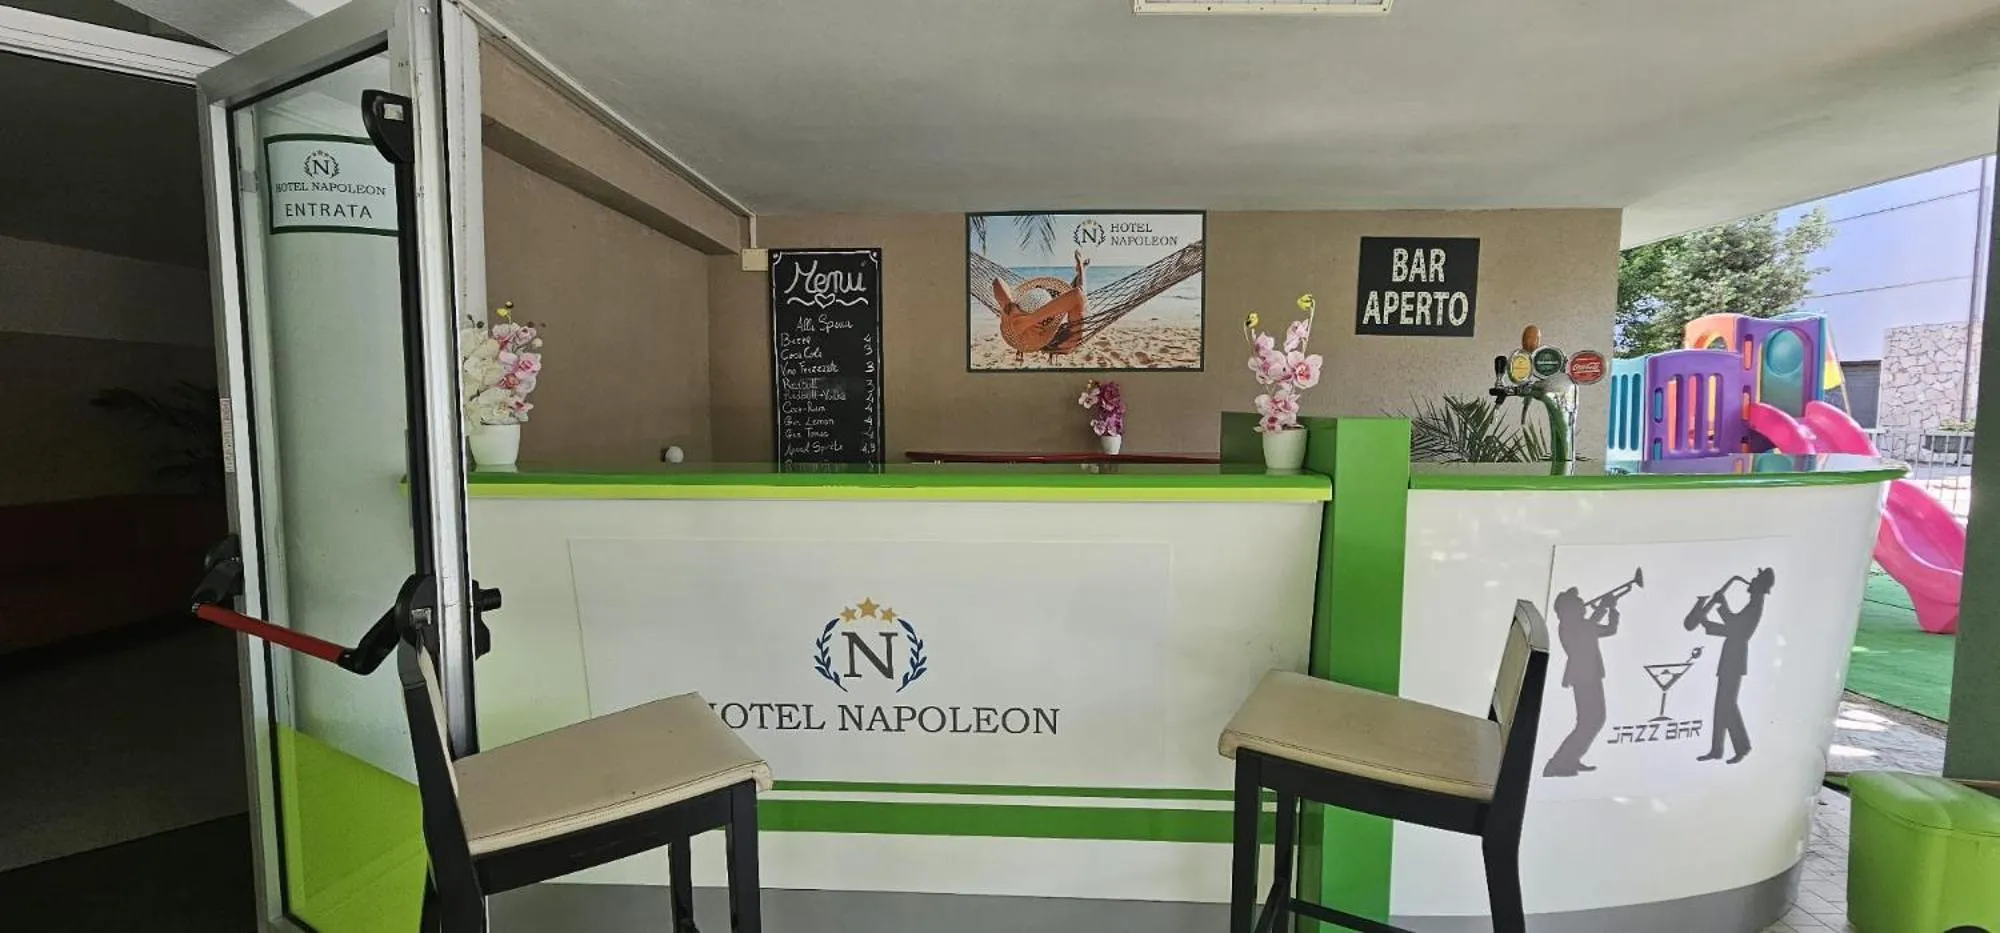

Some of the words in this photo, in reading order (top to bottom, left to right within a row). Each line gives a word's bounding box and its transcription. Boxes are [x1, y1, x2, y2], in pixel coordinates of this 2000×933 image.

[313, 159, 329, 176] N
[275, 182, 309, 193] HOTEL
[311, 183, 387, 196] NAPOLEON
[284, 203, 372, 219] ENTRATA
[1082, 228, 1097, 243] N
[1110, 222, 1153, 233] HOTEL
[1110, 235, 1178, 246] NAPOLEON
[1391, 247, 1447, 282] BAR
[1362, 290, 1469, 327] APERTO
[841, 630, 899, 680] N
[708, 702, 826, 730] OTEL
[837, 703, 1061, 736] NAPOLEON
[1606, 723, 1662, 745] JAZZ
[1664, 719, 1703, 741] BAR
